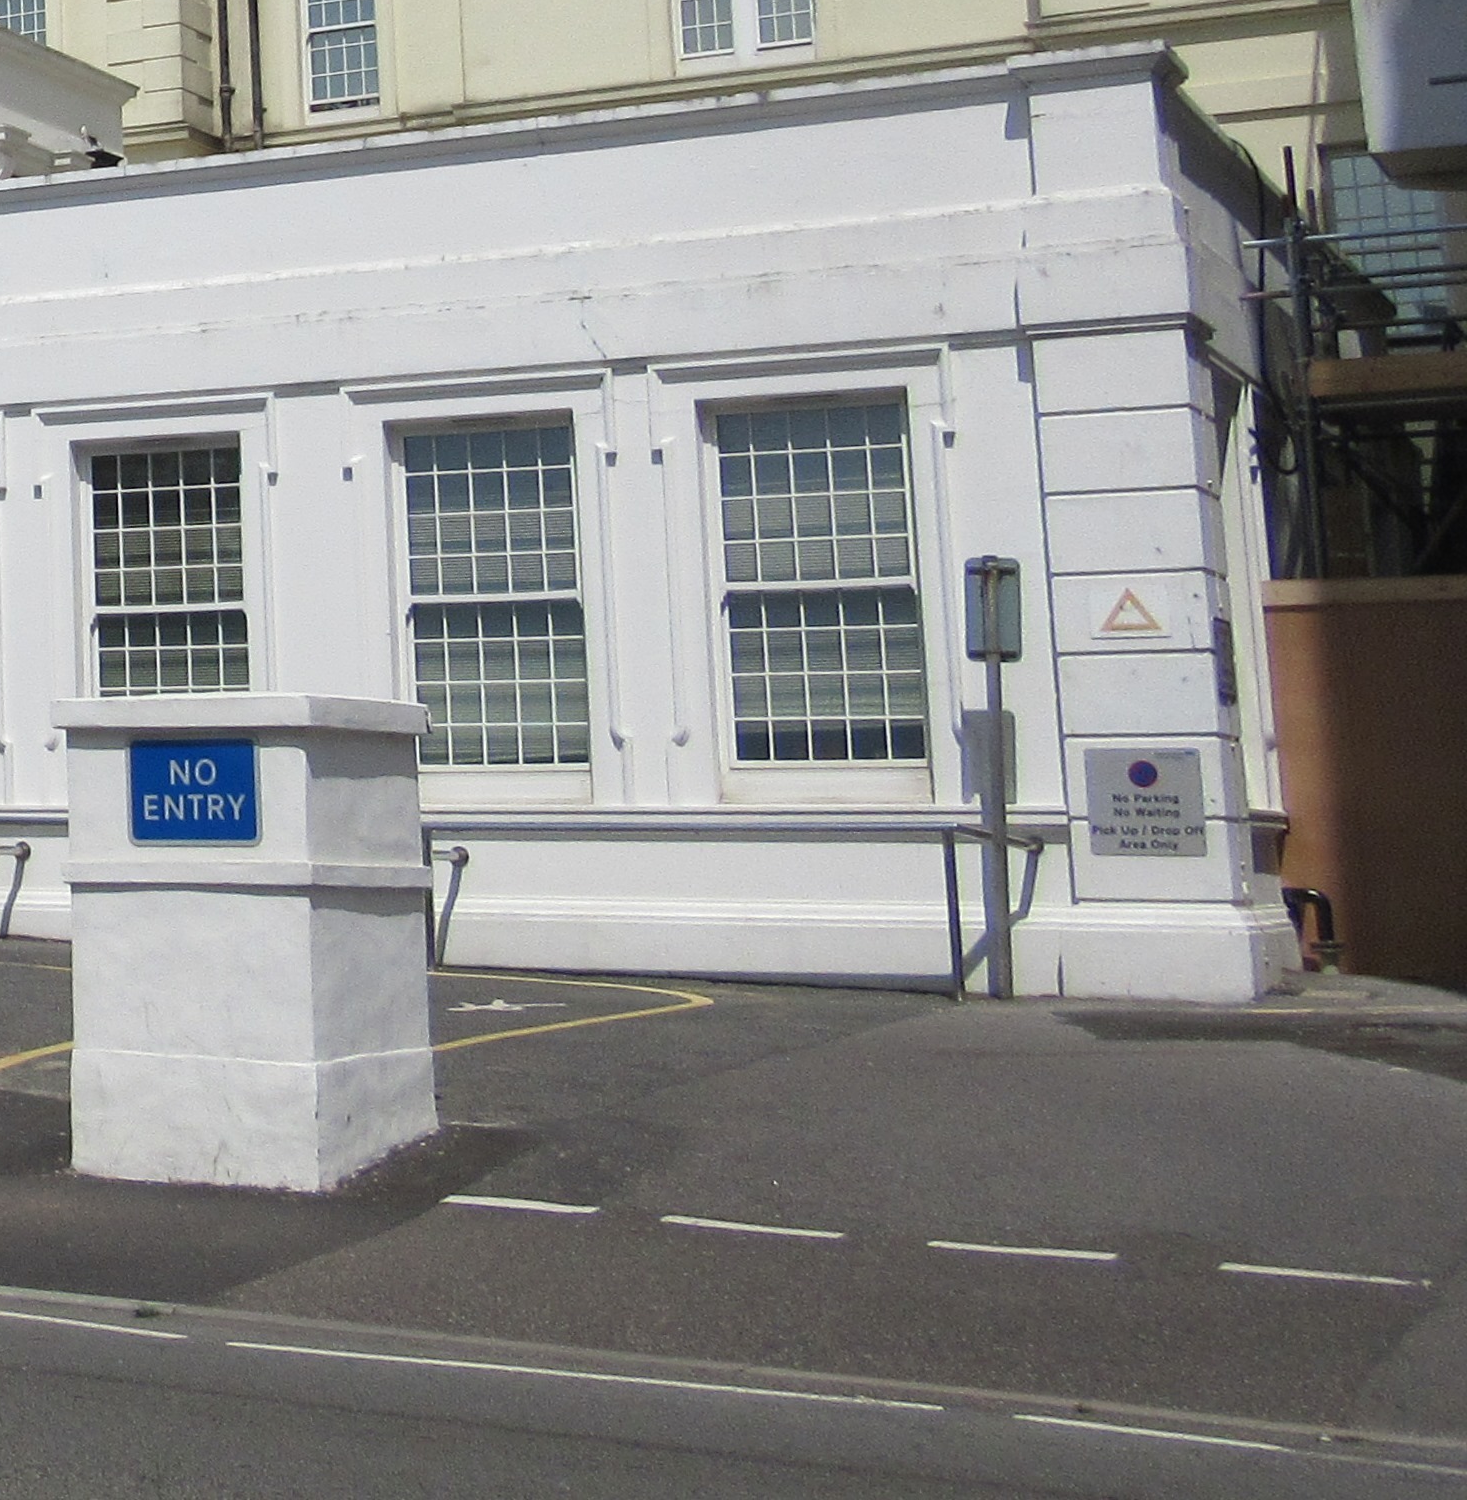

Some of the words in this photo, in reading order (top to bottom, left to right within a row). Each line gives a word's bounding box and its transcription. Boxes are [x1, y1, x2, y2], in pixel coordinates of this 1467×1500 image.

[169, 759, 217, 786] NO
[1112, 793, 1129, 803] No
[1134, 794, 1180, 804] Parking
[143, 794, 246, 821] ENTRY
[1114, 808, 1130, 817] No
[1136, 807, 1180, 819] Waiting
[1092, 825, 1116, 835] Pick
[1121, 825, 1139, 836] Up
[1151, 825, 1181, 836] Drop
[1185, 825, 1204, 835] Off
[1120, 839, 1147, 849] Area
[1151, 839, 1179, 851] Only
